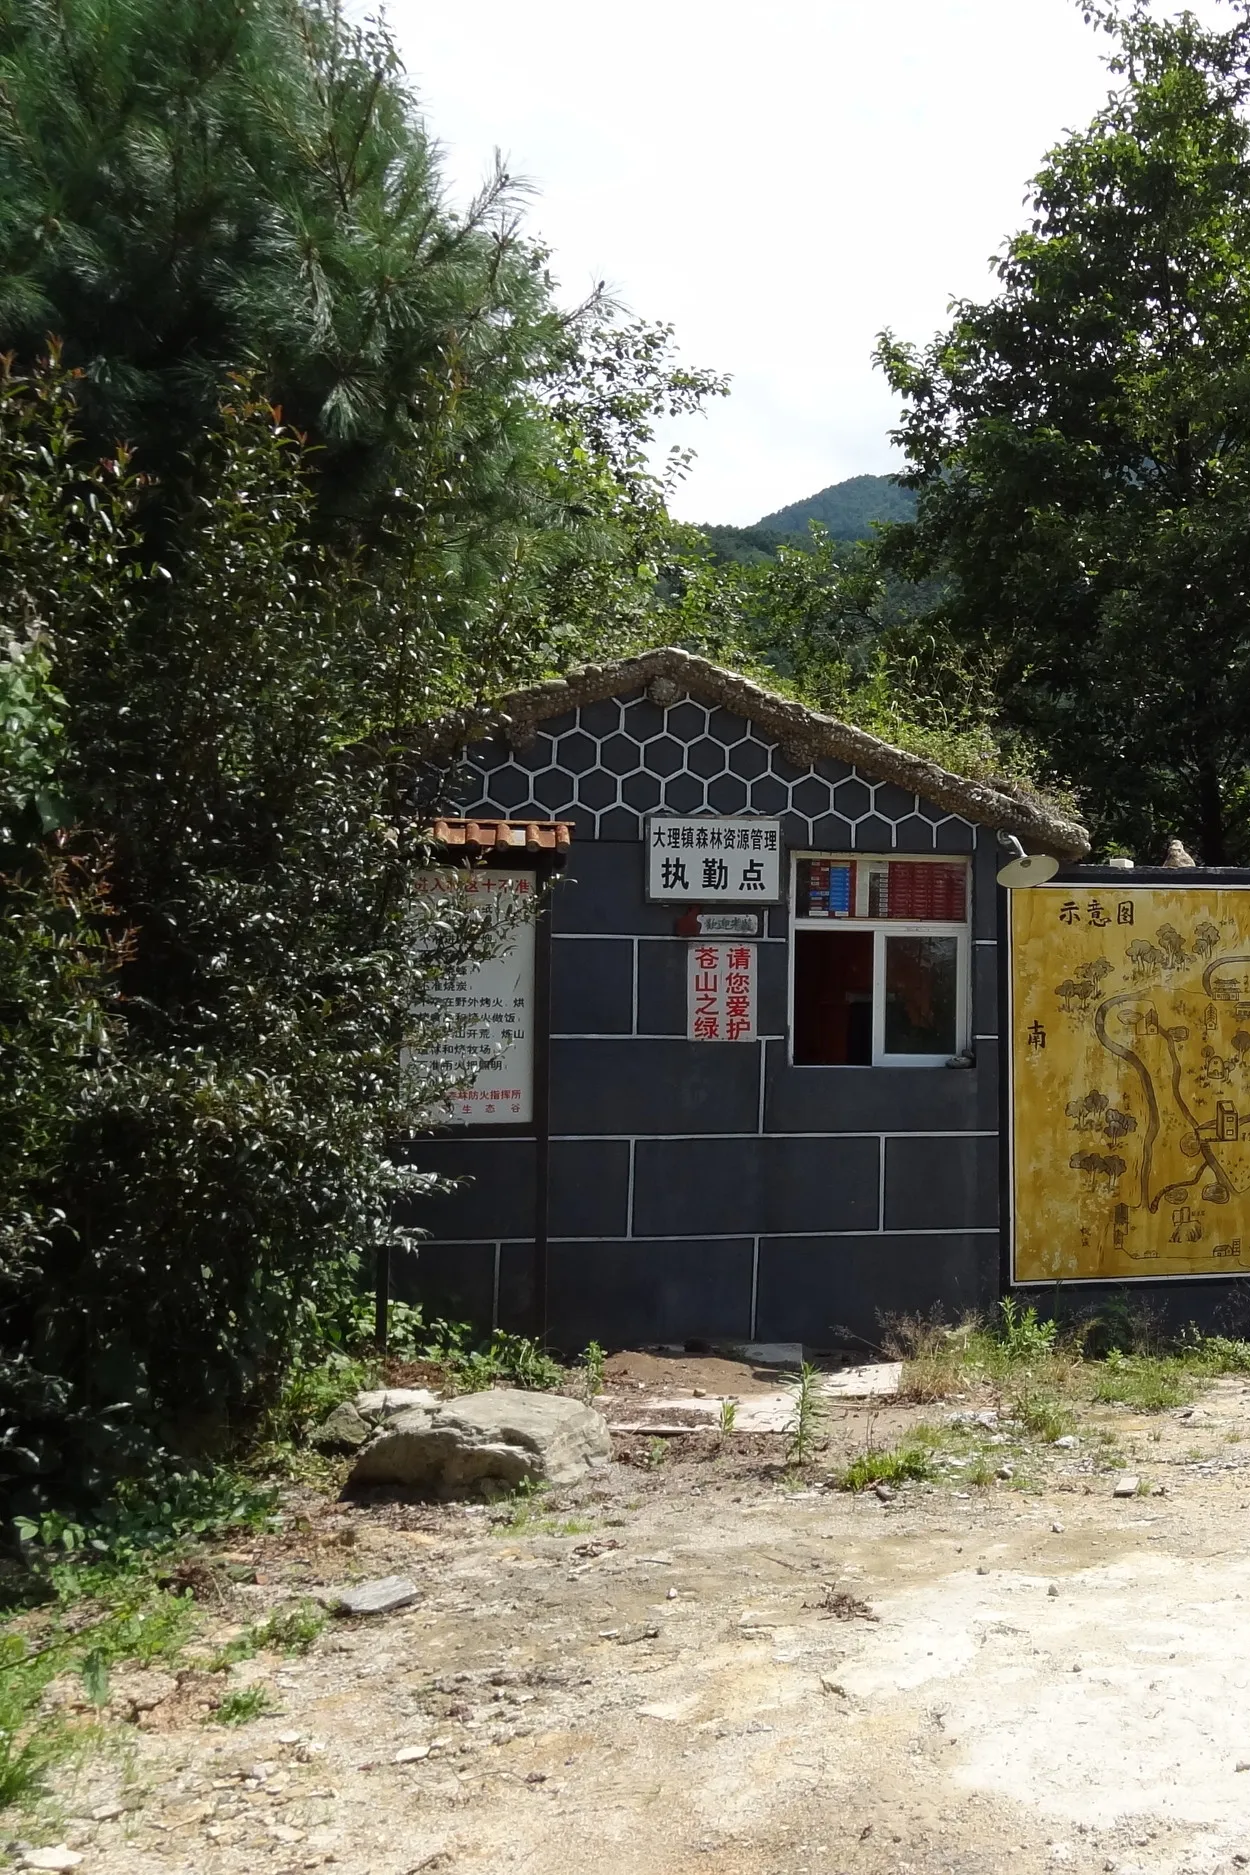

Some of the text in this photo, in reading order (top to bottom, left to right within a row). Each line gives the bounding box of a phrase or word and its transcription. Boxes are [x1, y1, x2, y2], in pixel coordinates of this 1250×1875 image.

[653, 826, 777, 851] 大理镇森林资源管理
[661, 857, 765, 890] 执勤点
[1059, 900, 1134, 927] 示意图
[694, 948, 719, 1040] 苍山之绿
[726, 948, 751, 1041] 请您爱护
[1027, 1020, 1046, 1050] 南
